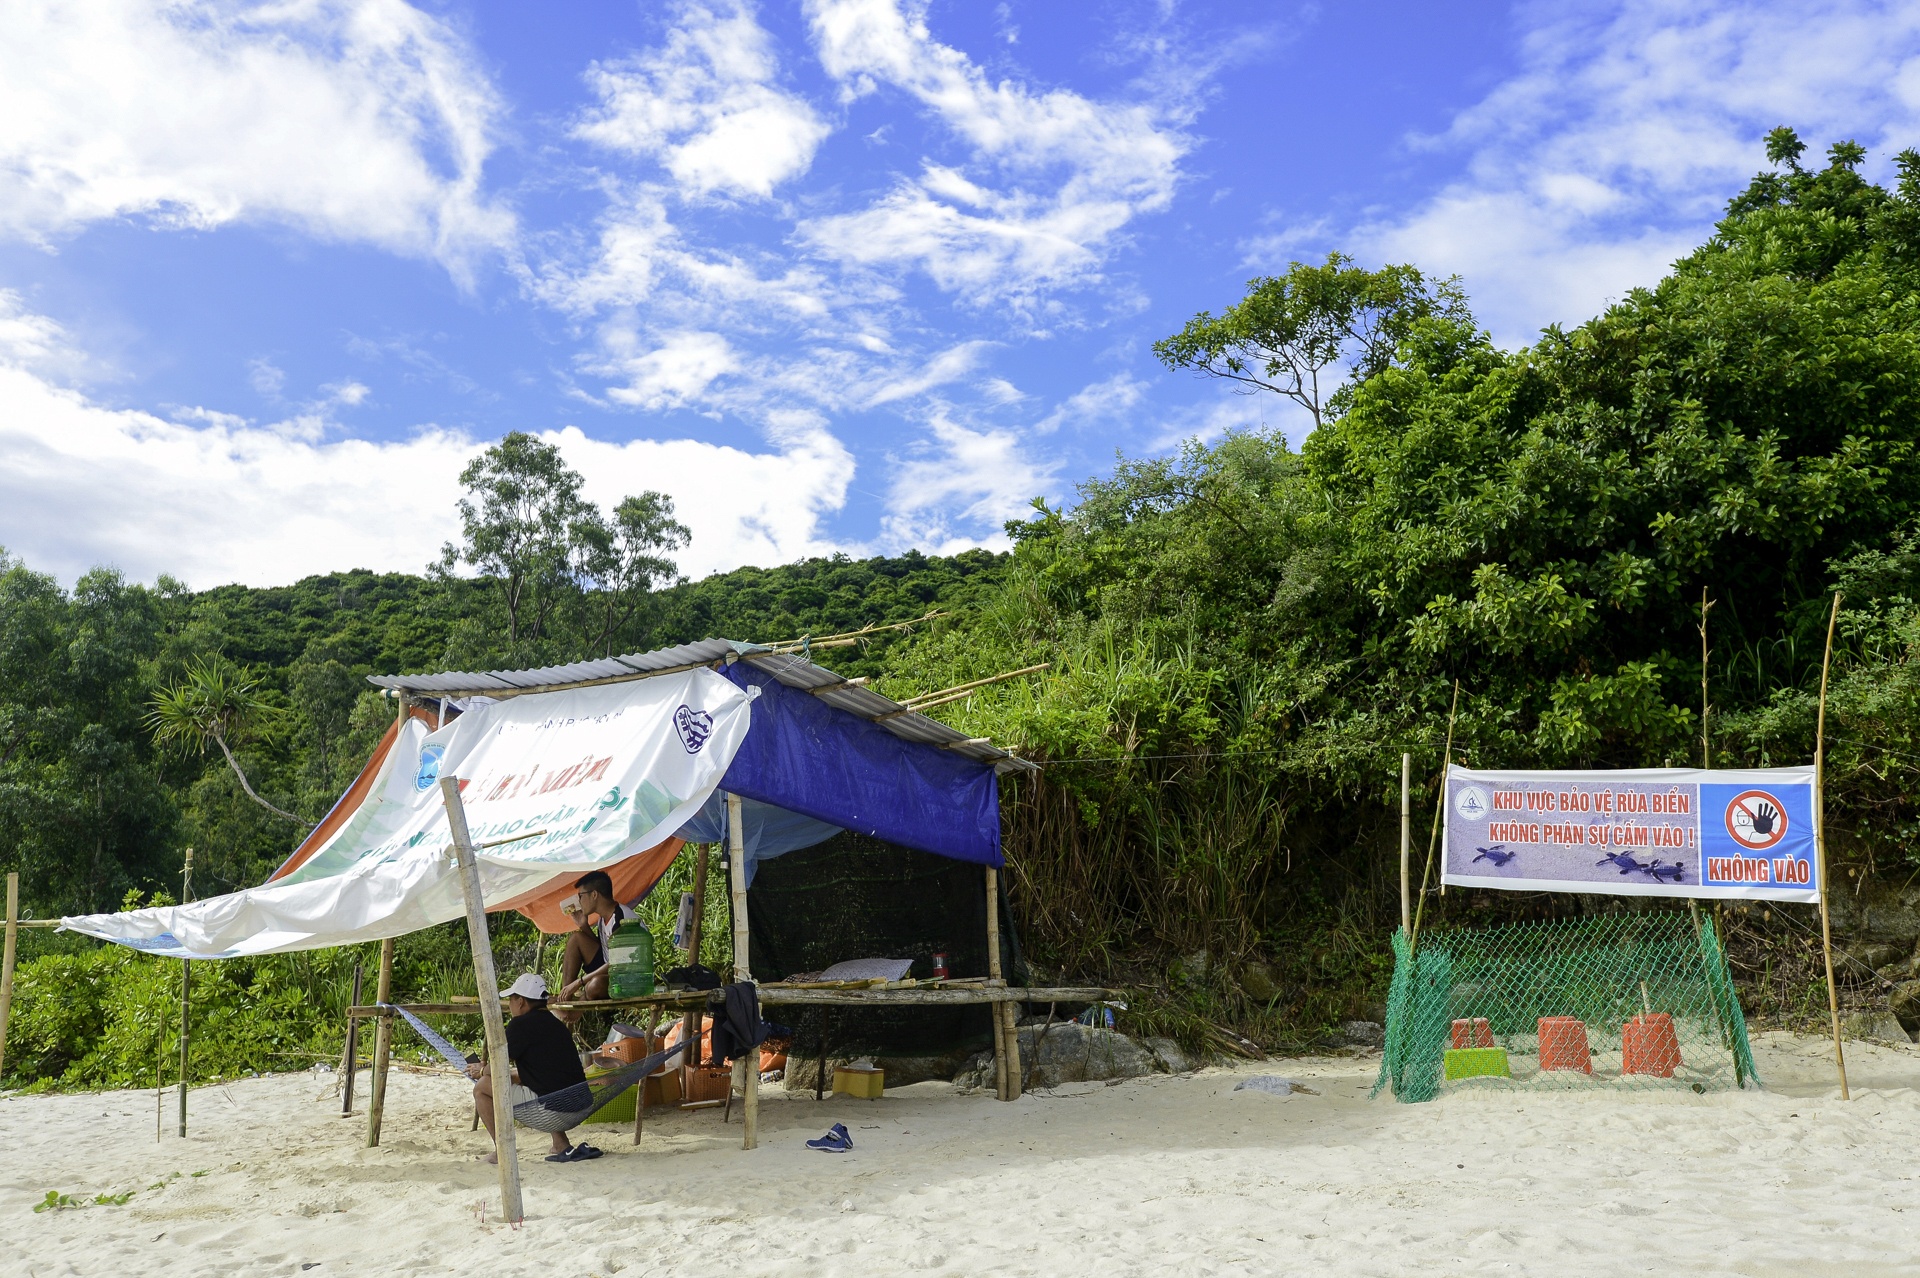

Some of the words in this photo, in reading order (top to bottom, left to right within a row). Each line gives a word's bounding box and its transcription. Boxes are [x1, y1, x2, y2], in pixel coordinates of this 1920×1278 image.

[1493, 791, 1523, 810] KHU
[1527, 790, 1556, 815] VỰC
[1560, 786, 1590, 812] BẢO
[1594, 789, 1613, 816] VỆ
[1617, 789, 1649, 813] RÙA
[1652, 786, 1690, 814] BIỂN
[486, 819, 525, 839] LAO
[1489, 819, 1540, 843] KHÔNG
[1543, 820, 1585, 847] PHẬN
[1588, 824, 1610, 849] SỰ
[1613, 819, 1649, 846] CẤM
[1652, 822, 1684, 847] VÀO
[1688, 827, 1694, 848] !
[1708, 854, 1769, 882] KHÔNG
[1773, 855, 1809, 883] VÀO
